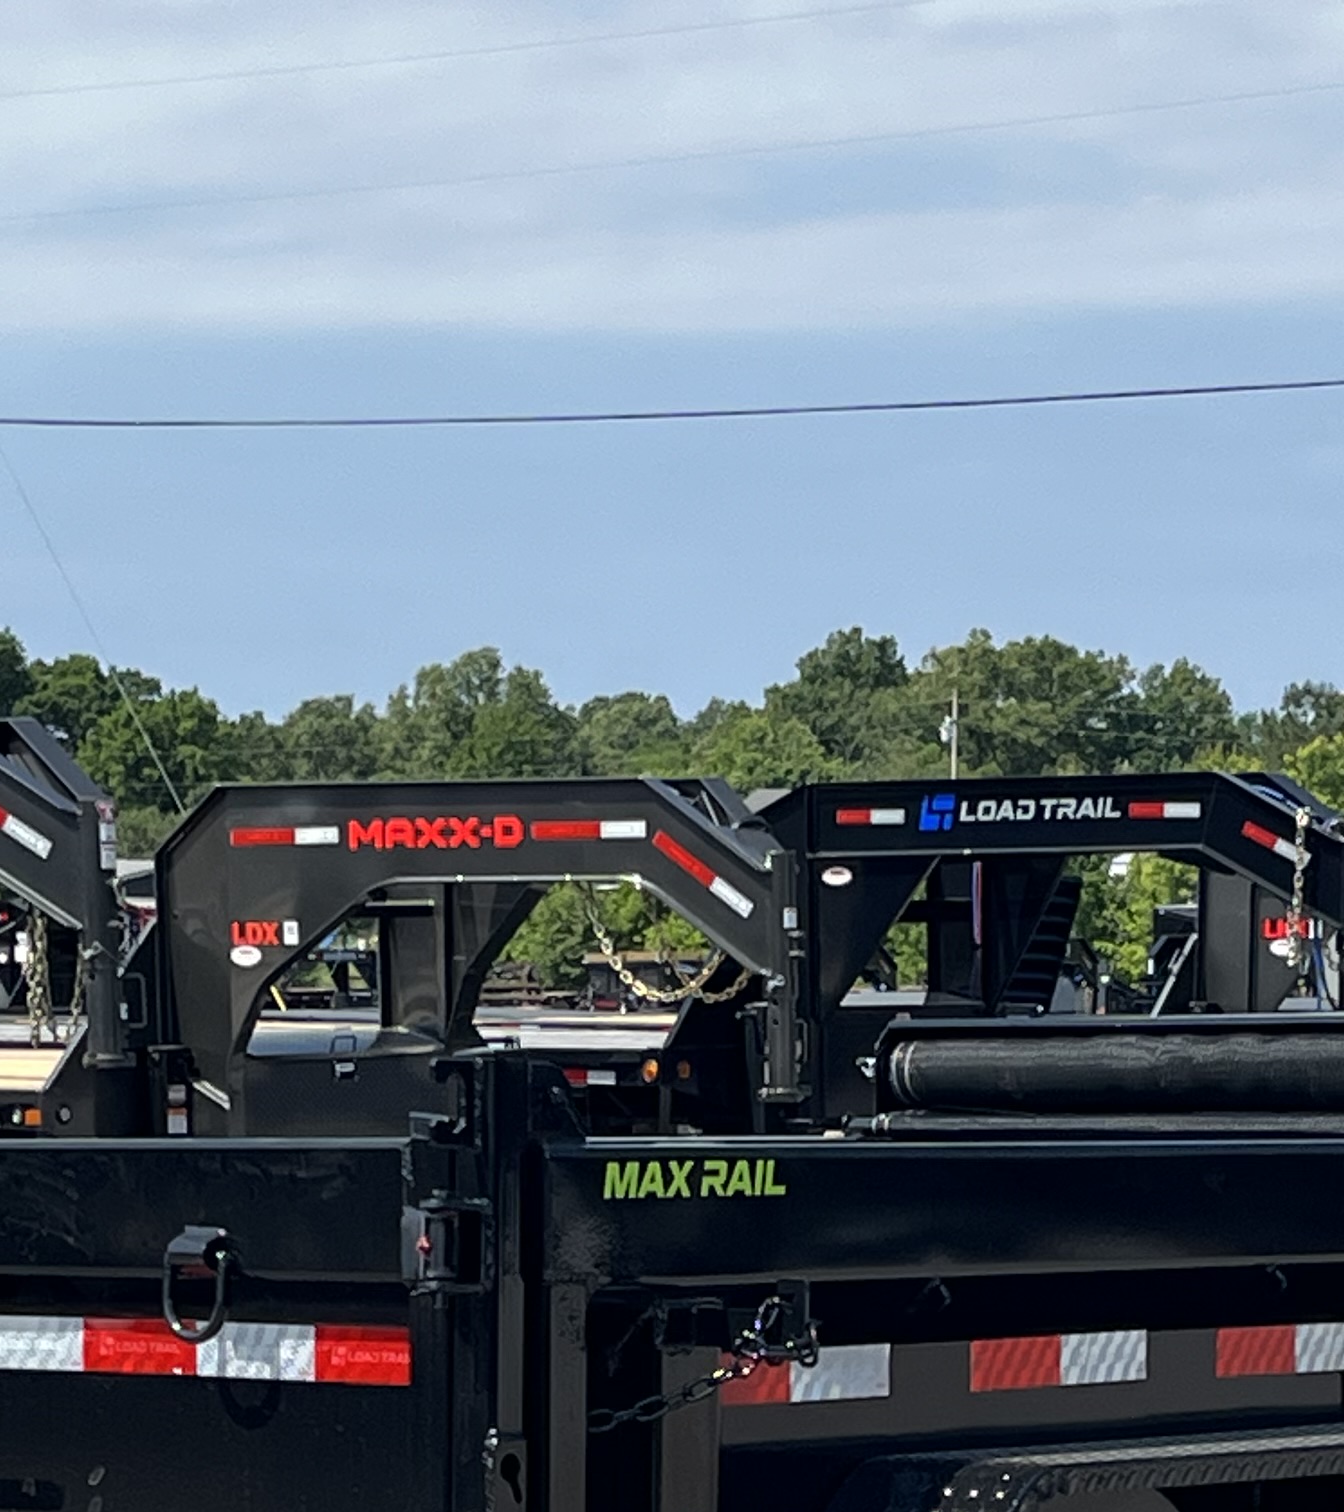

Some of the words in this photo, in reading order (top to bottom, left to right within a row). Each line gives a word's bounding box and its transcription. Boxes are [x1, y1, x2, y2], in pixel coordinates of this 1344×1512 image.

[959, 799, 1037, 823] LOAD
[1040, 796, 1122, 821] TRAIL
[347, 813, 525, 851] MAXX-D
[230, 920, 280, 947] LDX
[603, 1159, 695, 1200] MAX
[700, 1158, 787, 1198] RAIL
